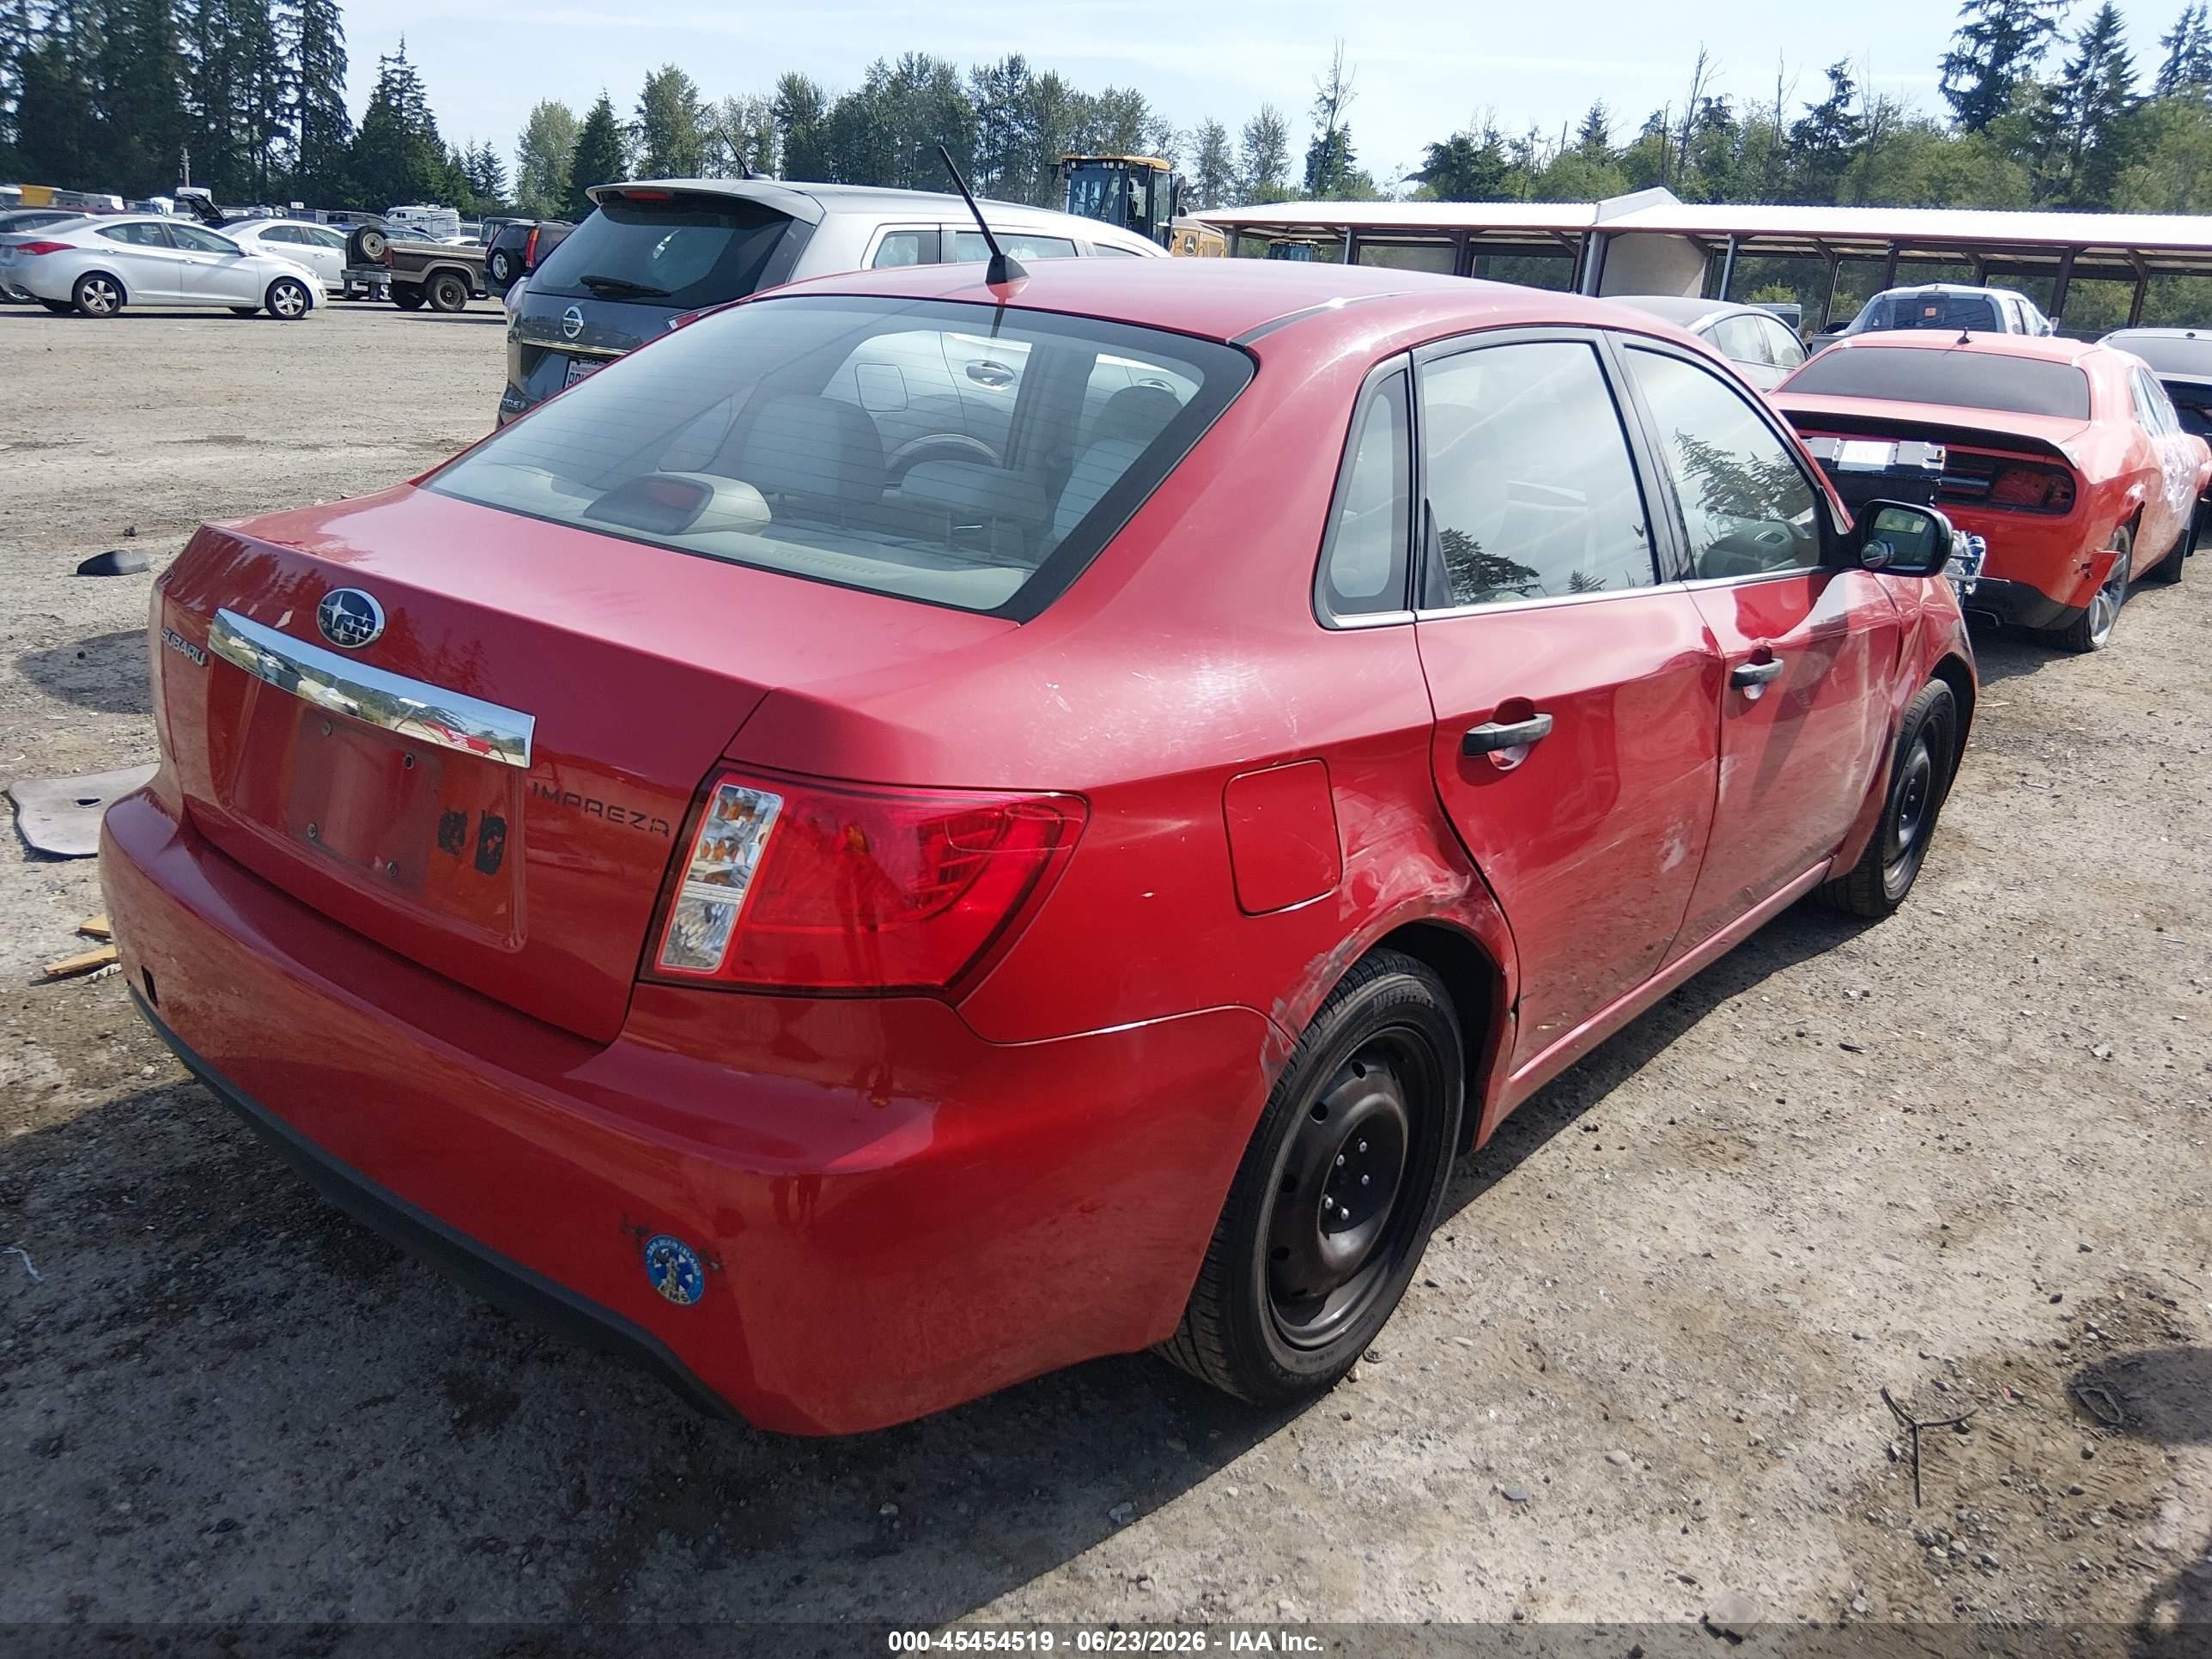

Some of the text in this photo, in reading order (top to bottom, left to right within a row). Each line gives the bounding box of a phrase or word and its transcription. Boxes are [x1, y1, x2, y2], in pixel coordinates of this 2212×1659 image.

[161, 626, 207, 667] SUBARU
[532, 781, 670, 838] IMPREZA
[678, 1246, 702, 1276] ISLAND
[659, 1285, 689, 1303] EMS
